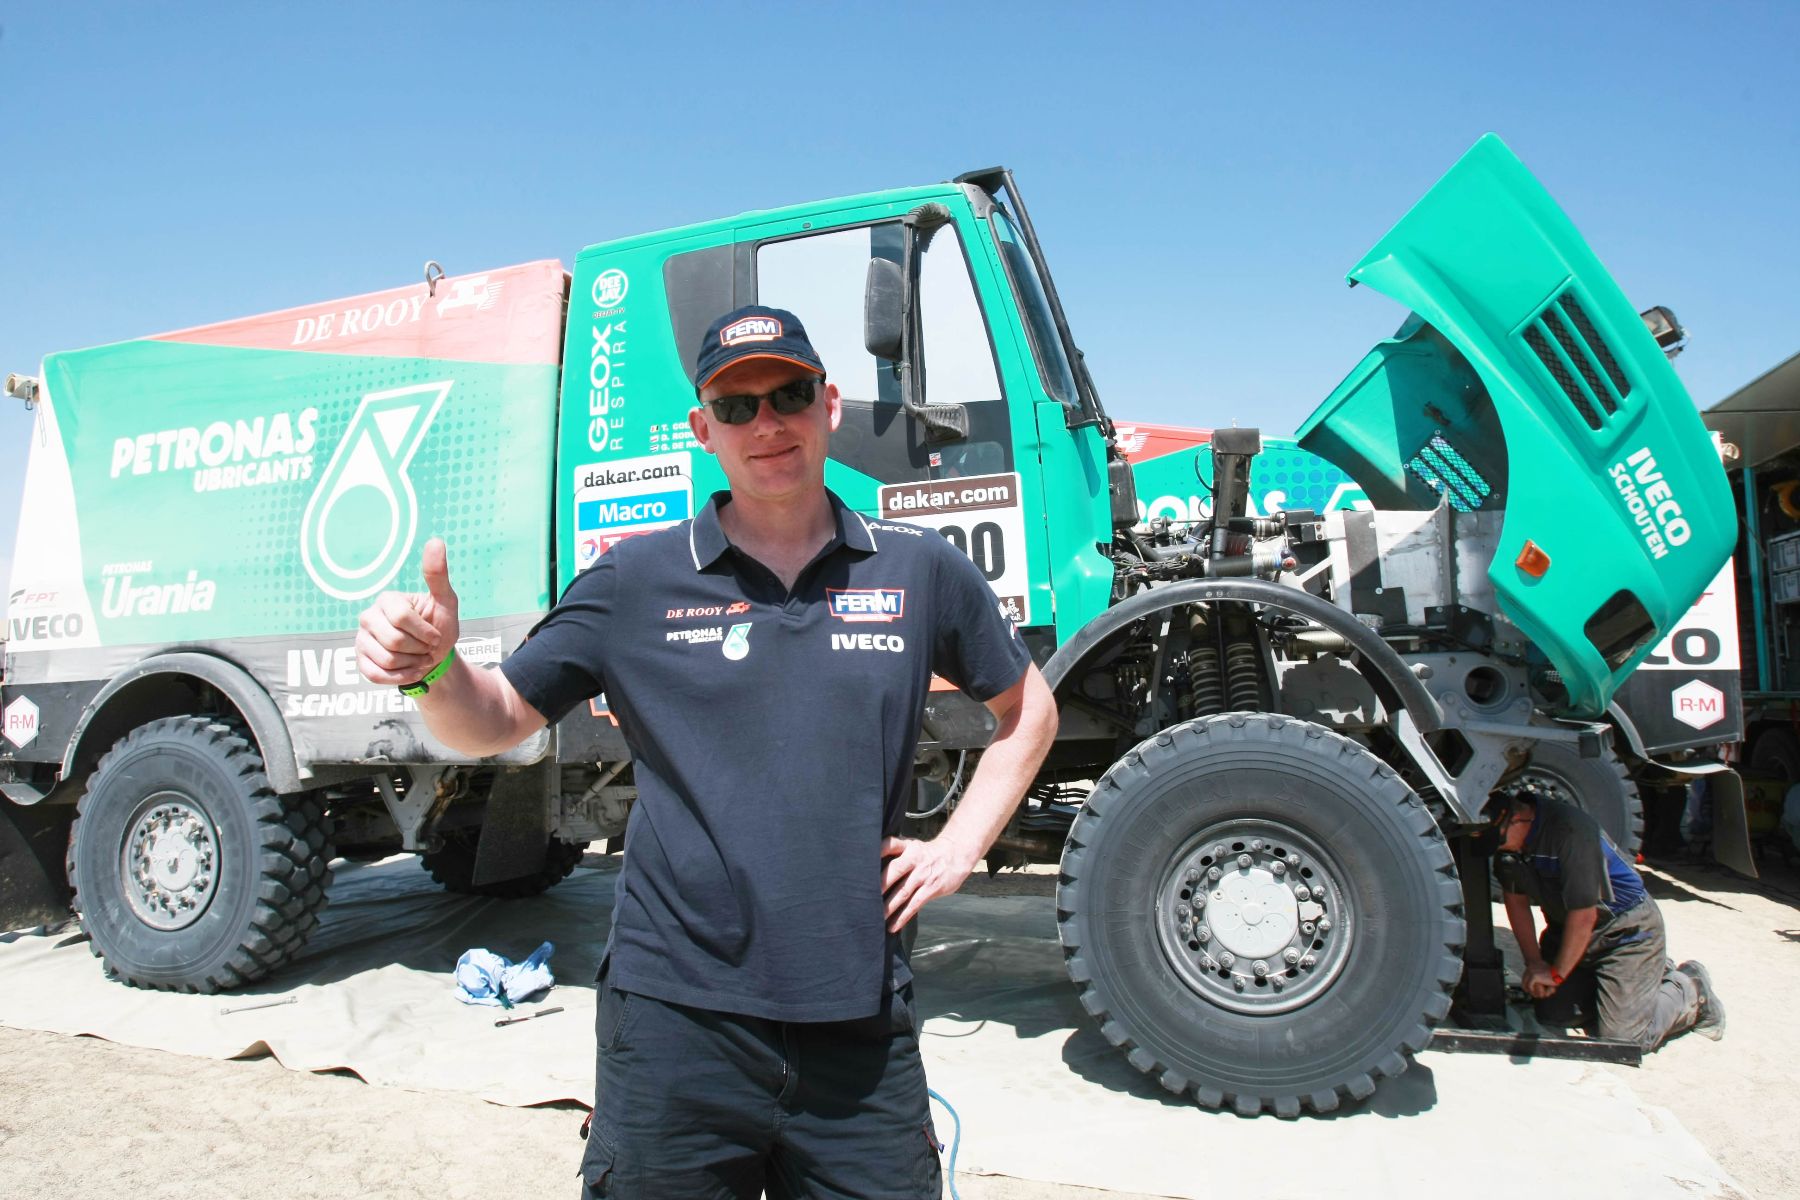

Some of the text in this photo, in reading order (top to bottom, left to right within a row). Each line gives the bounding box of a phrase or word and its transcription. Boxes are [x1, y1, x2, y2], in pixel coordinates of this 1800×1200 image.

[292, 293, 427, 344] DE ROOY
[726, 320, 776, 341] FERM
[589, 324, 611, 452] GEOX
[610, 320, 627, 451] RESPIRA
[111, 408, 318, 478] PETRONAS
[584, 464, 681, 488] dakar.com
[889, 485, 1009, 511] dakar.com
[1626, 446, 1692, 547] IVECO
[598, 501, 667, 524] Macro
[1607, 462, 1669, 560] SCHOUTEN
[25, 592, 59, 603] FPT
[102, 571, 216, 618] Urania
[835, 591, 897, 612] FERM
[666, 606, 723, 619] DE ROOY
[666, 626, 723, 642] PETRONAS
[831, 633, 904, 653] IVECO
[288, 647, 359, 686] IVE
[1680, 698, 1716, 712] R-M
[10, 713, 34, 729] R-M
